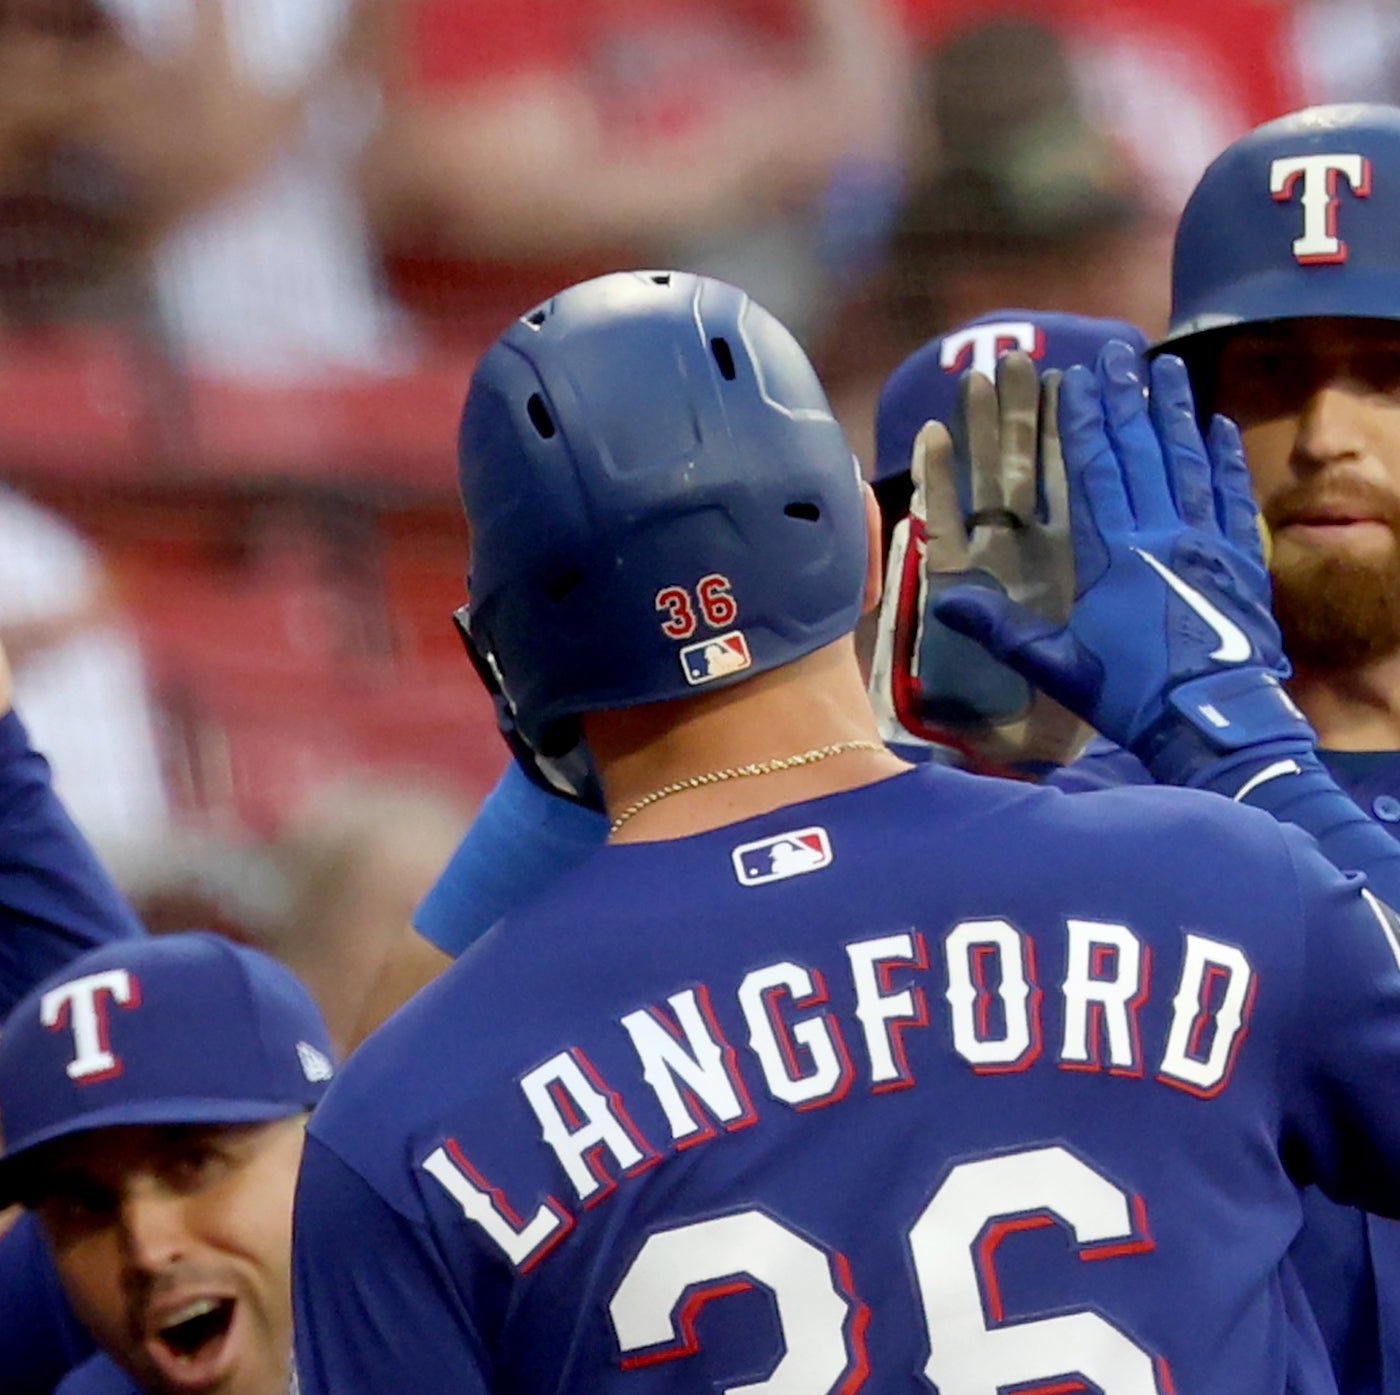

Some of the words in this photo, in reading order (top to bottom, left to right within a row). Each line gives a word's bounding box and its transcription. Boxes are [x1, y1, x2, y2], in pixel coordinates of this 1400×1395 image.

[1269, 154, 1373, 265] T
[655, 573, 738, 640] 36
[40, 968, 143, 1086] T
[422, 917, 1257, 1273] LANGFORD
